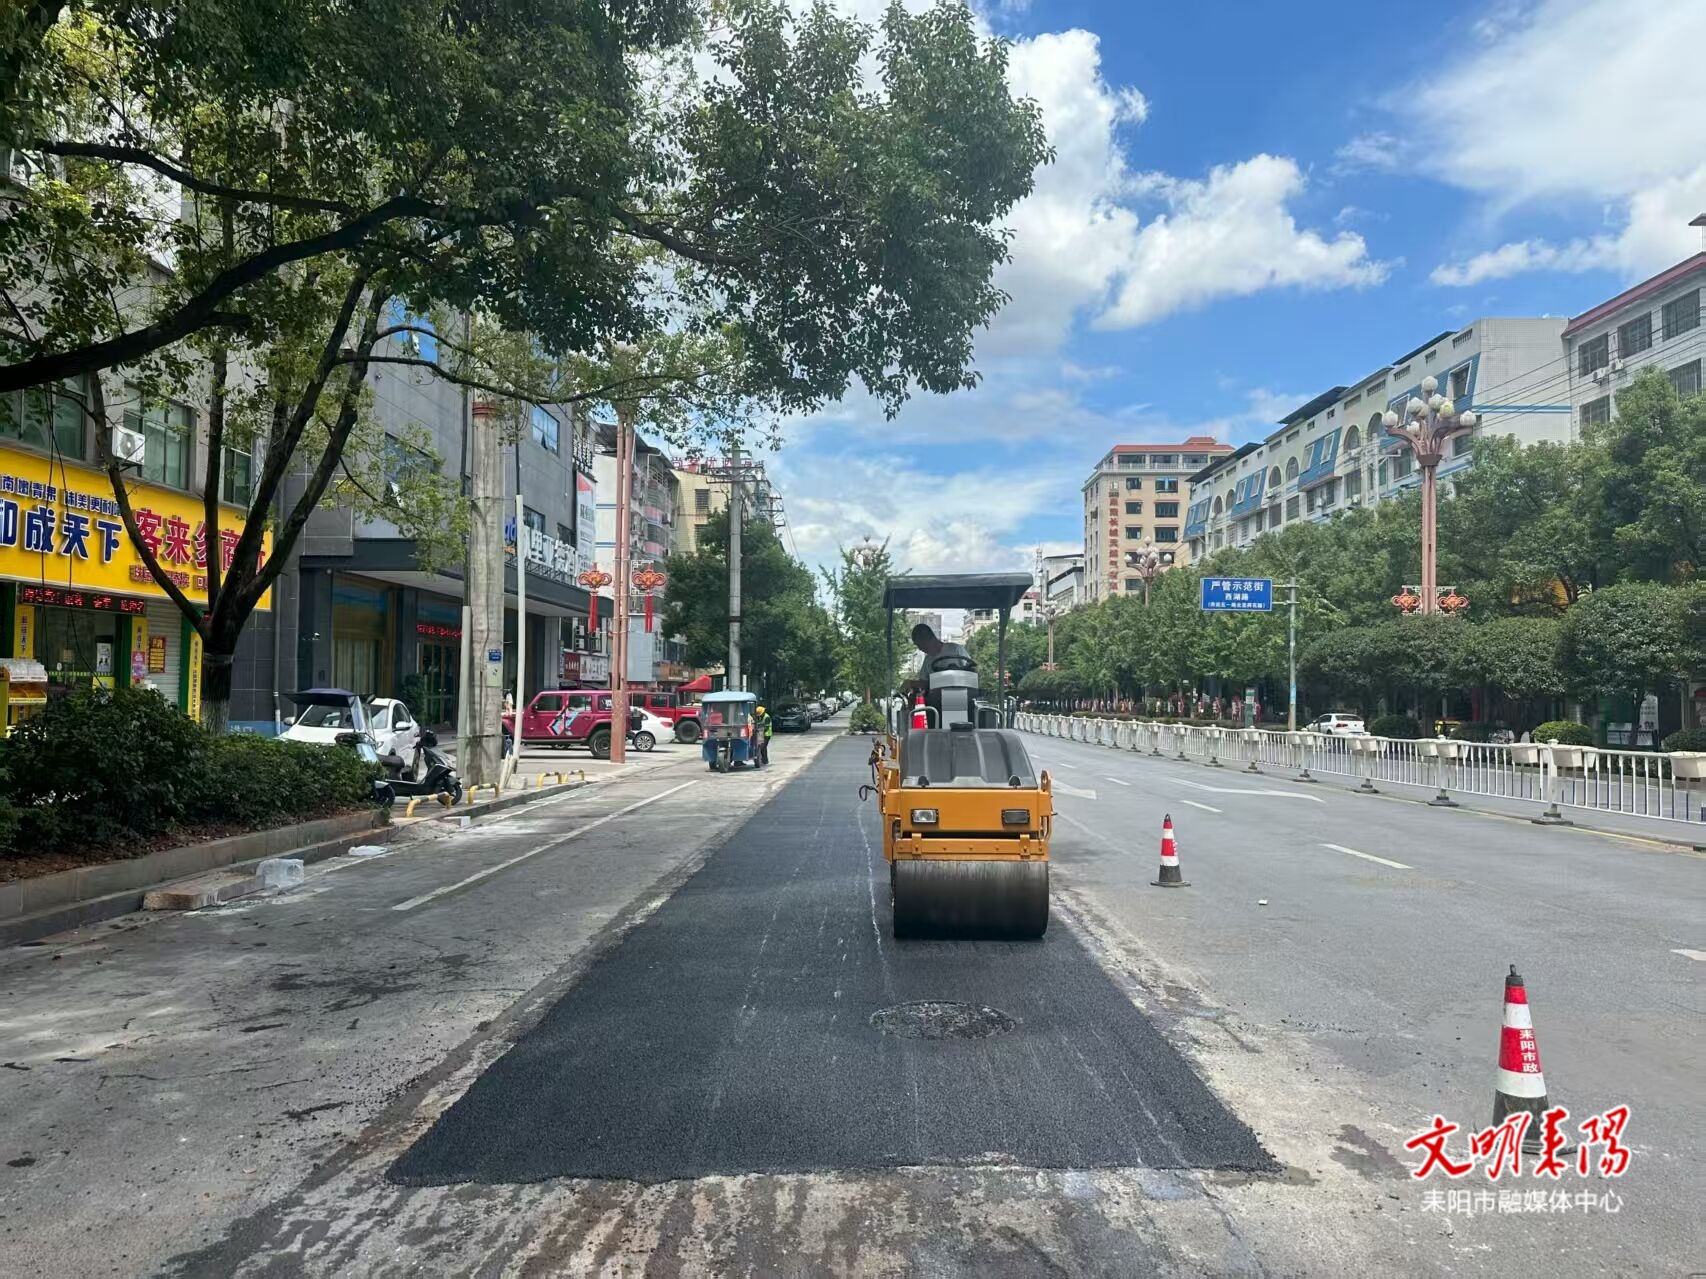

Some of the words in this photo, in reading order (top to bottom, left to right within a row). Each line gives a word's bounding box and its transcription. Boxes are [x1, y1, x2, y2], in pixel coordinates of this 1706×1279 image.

[0, 475, 56, 501] 南嫩青果
[1210, 580, 1264, 591] 严管示范街
[1520, 1029, 1538, 1073] 耒阳市政
